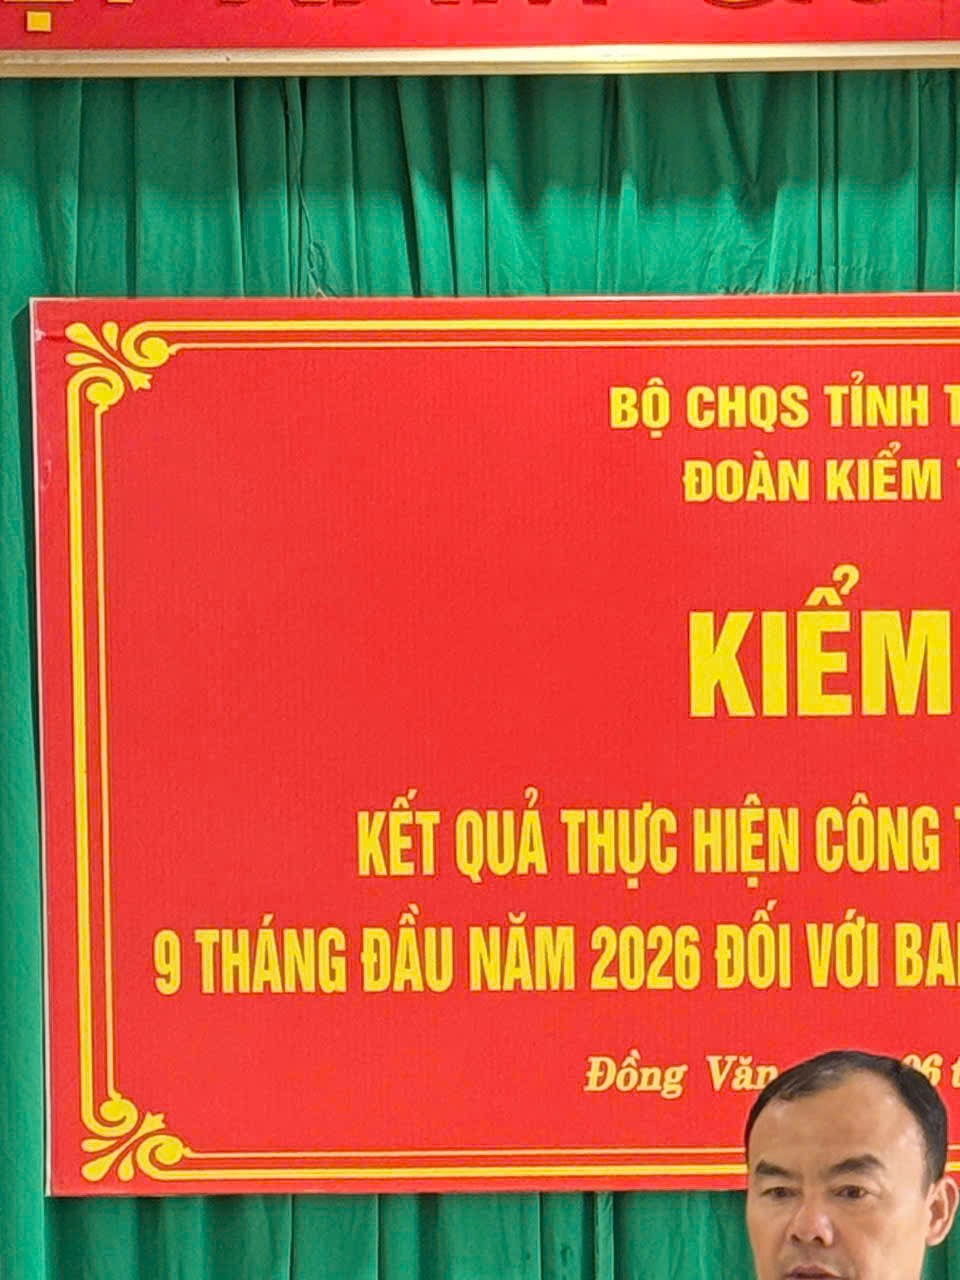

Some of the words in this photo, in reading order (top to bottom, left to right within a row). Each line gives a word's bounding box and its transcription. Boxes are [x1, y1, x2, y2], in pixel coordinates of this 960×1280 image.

[610, 378, 670, 438] BỘ
[686, 384, 809, 434] CHQS
[823, 372, 929, 428] TỈNH
[682, 450, 810, 502] ĐOÀN
[826, 441, 942, 501] KIỂM
[689, 564, 951, 717] KIỂM
[357, 789, 441, 876] KẾT
[455, 787, 547, 883] QUẢ
[560, 801, 677, 889] THỰC
[693, 793, 799, 888] HIỆN
[815, 792, 940, 873] CÔNG
[154, 929, 181, 995] 9
[195, 914, 347, 993] THÁNG
[360, 903, 453, 992] ĐẦU
[469, 912, 575, 991] NĂM
[591, 925, 701, 990] 2026
[714, 900, 791, 989] ĐỐI
[806, 908, 879, 988] VỚI
[584, 1049, 688, 1099] Đồng
